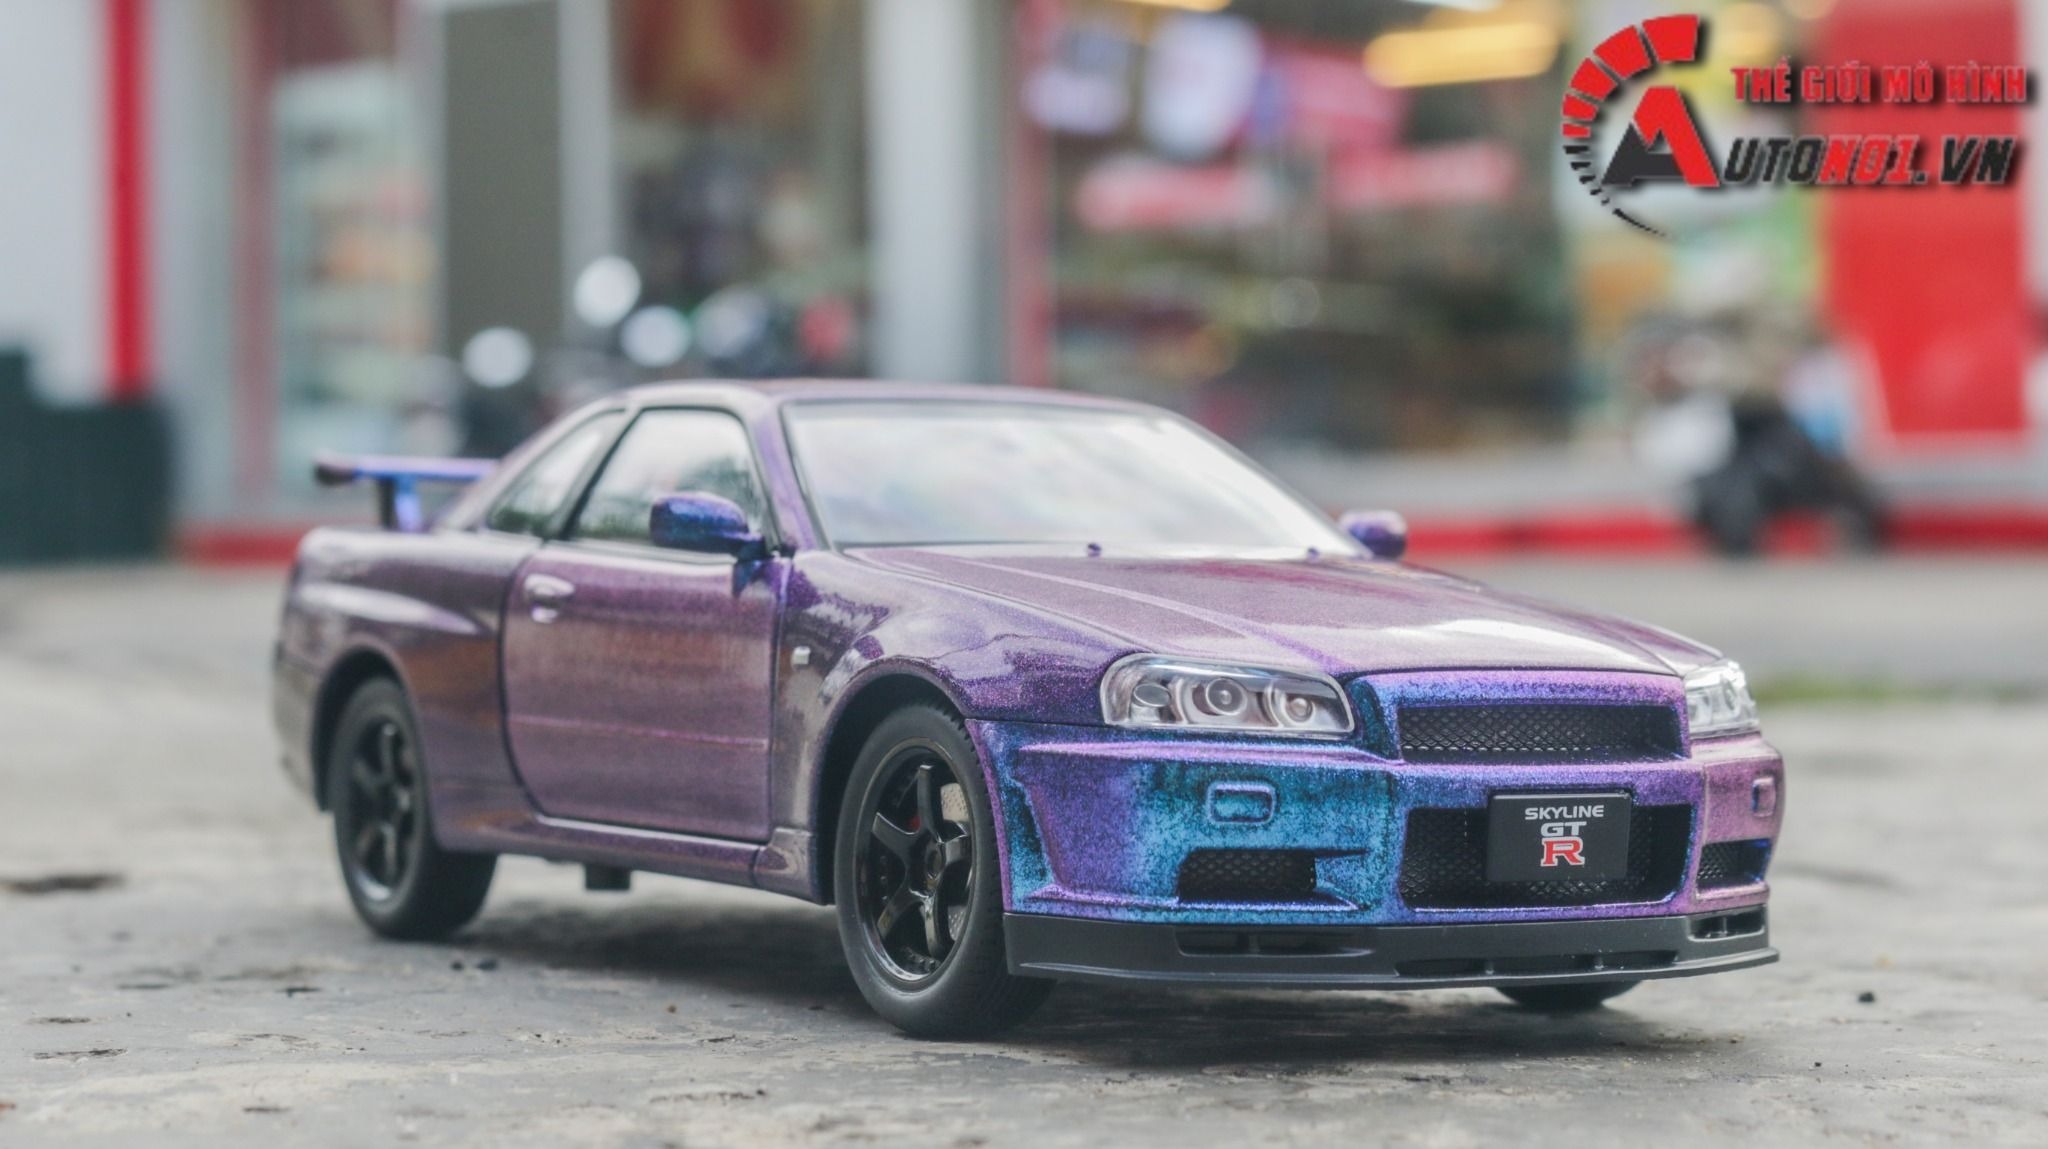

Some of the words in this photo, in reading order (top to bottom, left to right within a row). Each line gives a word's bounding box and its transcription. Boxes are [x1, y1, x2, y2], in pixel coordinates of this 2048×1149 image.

[1524, 804, 1604, 820] SKYLINE
[1540, 821, 1587, 836] GT
[1540, 836, 1585, 867] R
